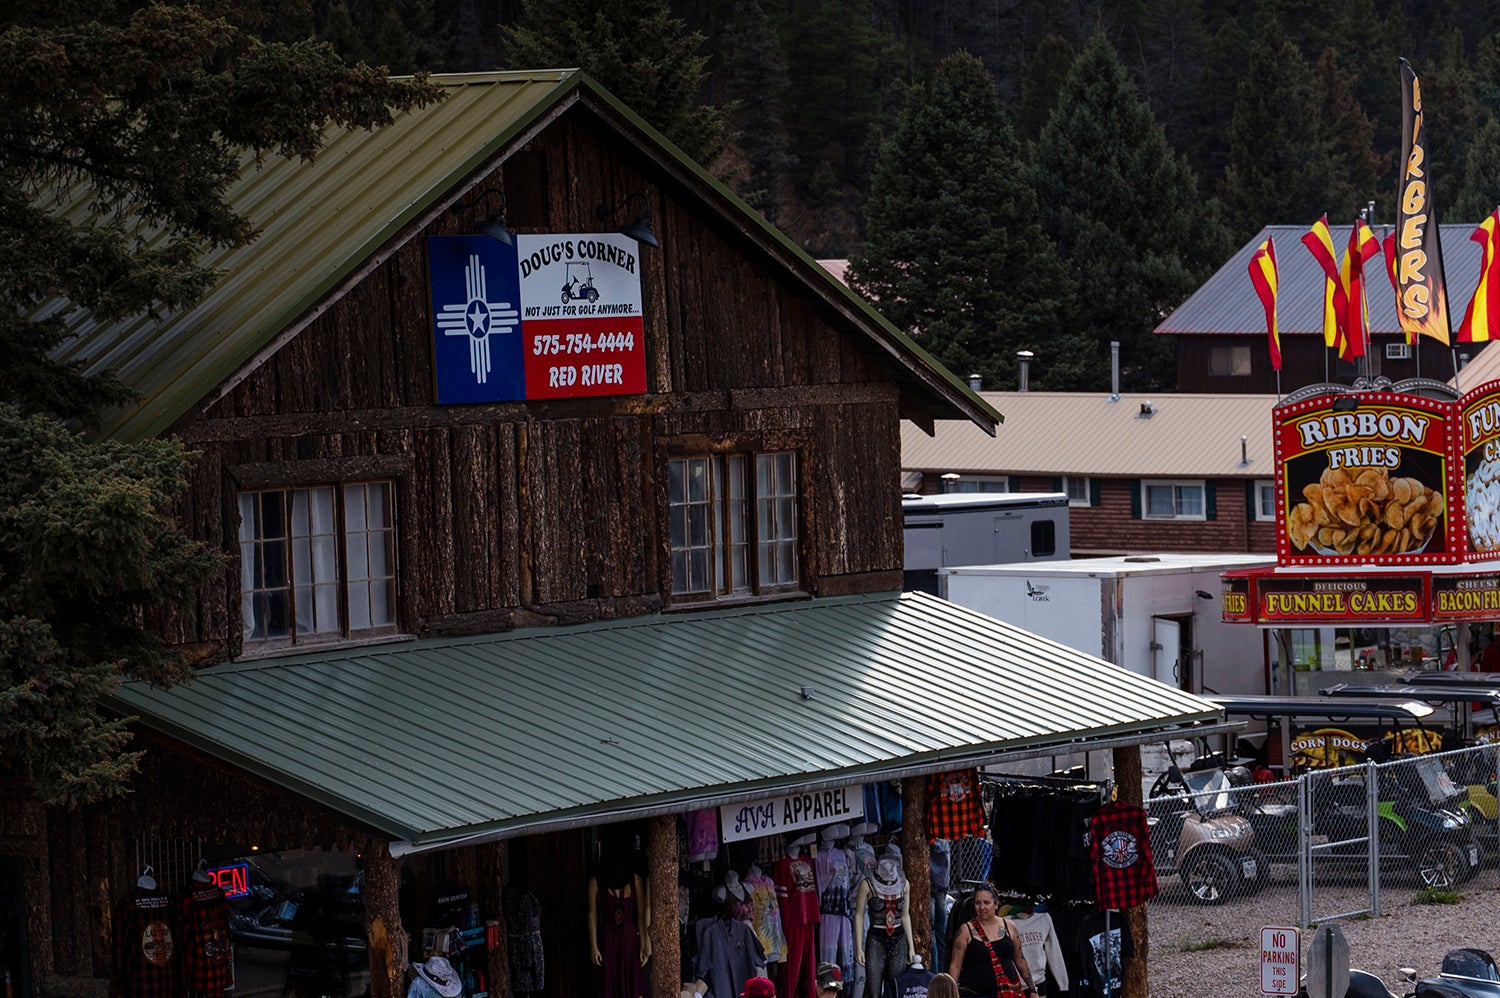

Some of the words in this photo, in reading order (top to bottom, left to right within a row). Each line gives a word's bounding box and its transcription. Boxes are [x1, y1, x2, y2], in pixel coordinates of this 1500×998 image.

[520, 240, 574, 279] DOUG'S
[578, 240, 635, 274] CORNER
[525, 306, 541, 317] NOT
[543, 306, 561, 316] JUST
[562, 305, 577, 316] FOR
[579, 305, 596, 316] GOLF
[598, 304, 640, 315] ANYMORE...
[533, 332, 634, 355] 575-754-4444
[549, 366, 577, 388] RED
[581, 364, 623, 386] RIVER
[1300, 414, 1428, 446] RIBBON
[1328, 447, 1400, 470] FRIES
[1315, 582, 1366, 591] DELICIOUS
[1458, 580, 1498, 588] CHEESY
[1267, 594, 1346, 612] FUNNEL
[1350, 594, 1416, 612] CAKES
[1439, 590, 1481, 611] BACON
[1291, 738, 1326, 752] CORN
[1333, 738, 1368, 751] DOGS
[735, 802, 776, 834] AVA
[783, 789, 850, 826] APPAREL
[207, 866, 248, 896] PEN
[1272, 934, 1286, 948] NO
[1263, 951, 1295, 964] PARKING
[1272, 967, 1286, 976] THIS
[1272, 979, 1286, 988] SIDE
